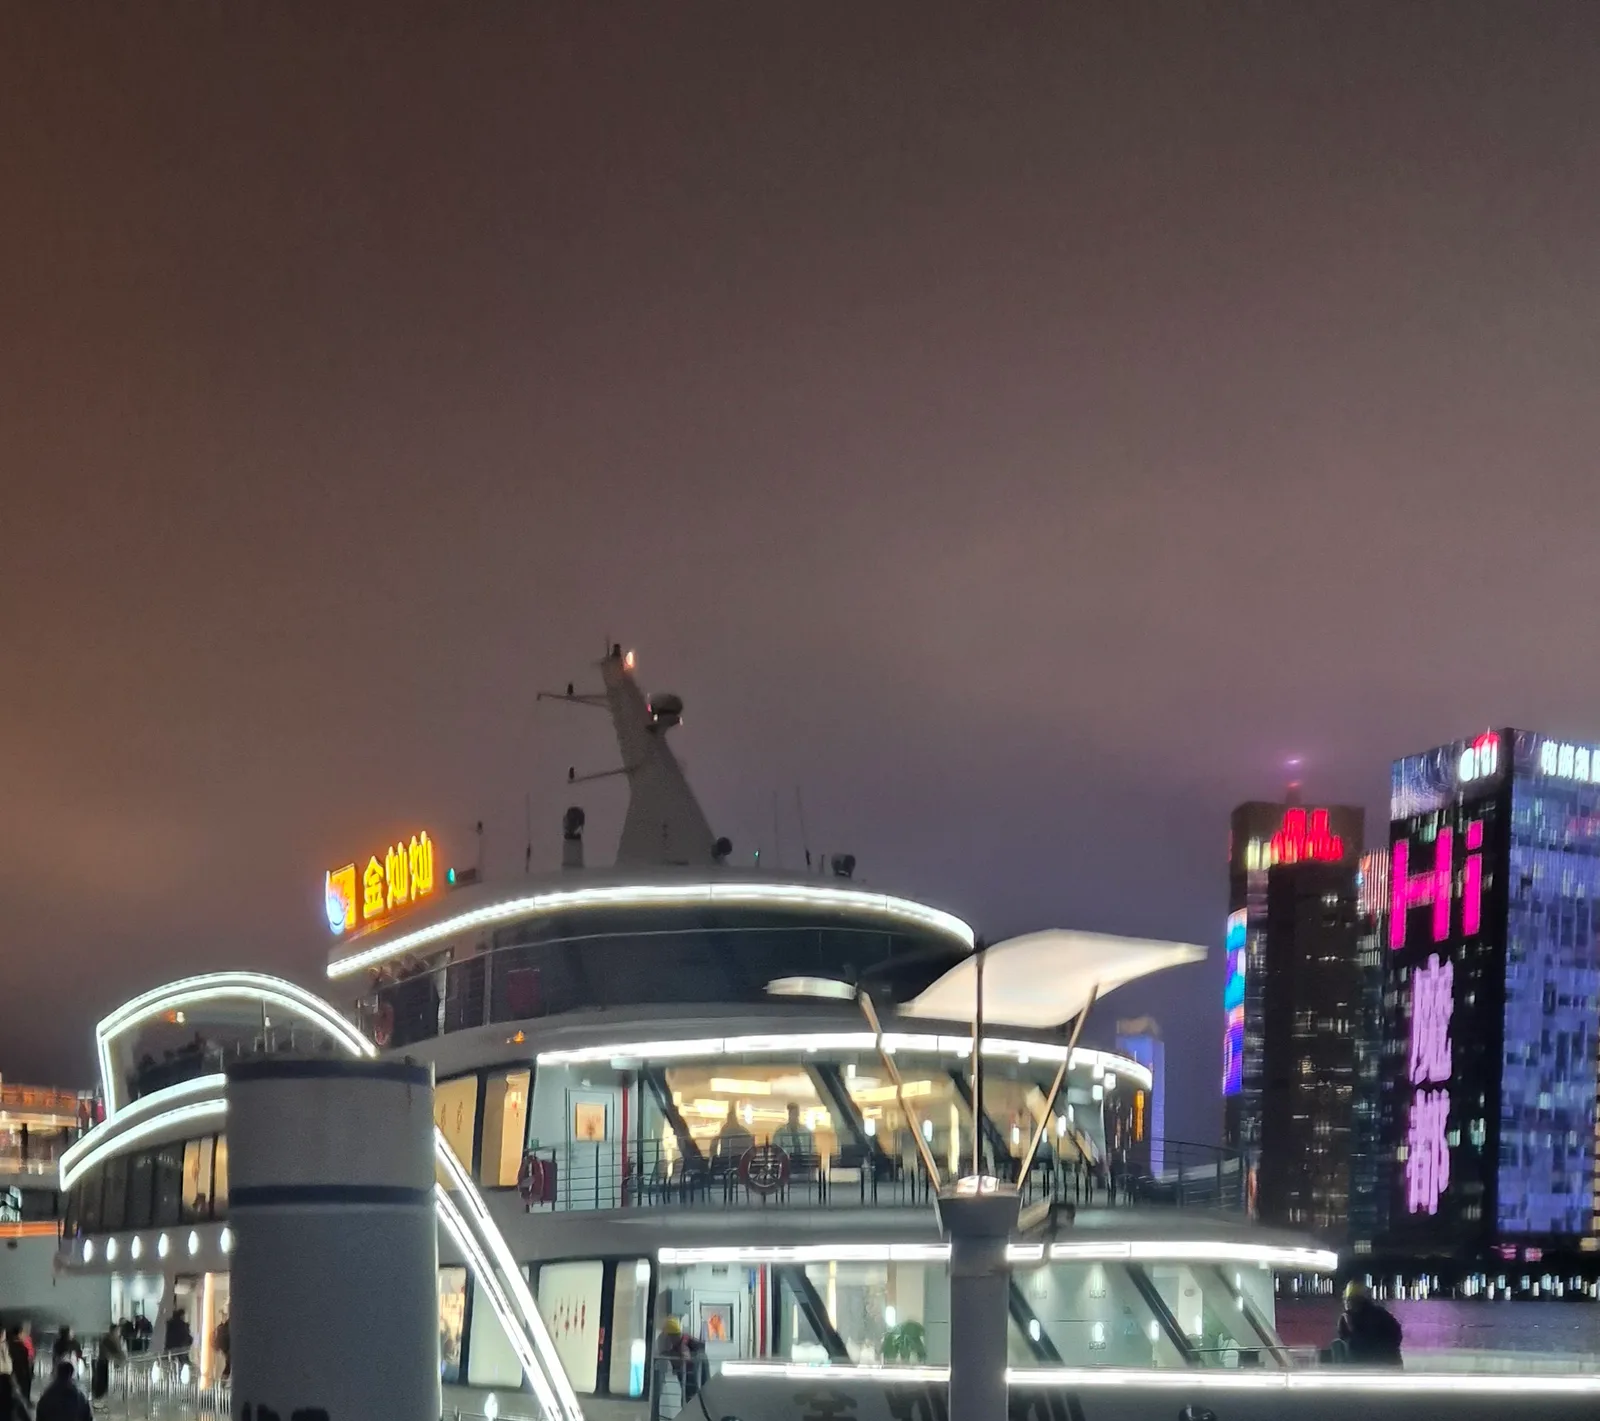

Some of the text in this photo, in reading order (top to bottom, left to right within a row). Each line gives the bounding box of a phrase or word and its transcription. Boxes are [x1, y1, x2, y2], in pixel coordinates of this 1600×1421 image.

[363, 830, 433, 919] 金灿灿
[1389, 820, 1483, 950] Hi
